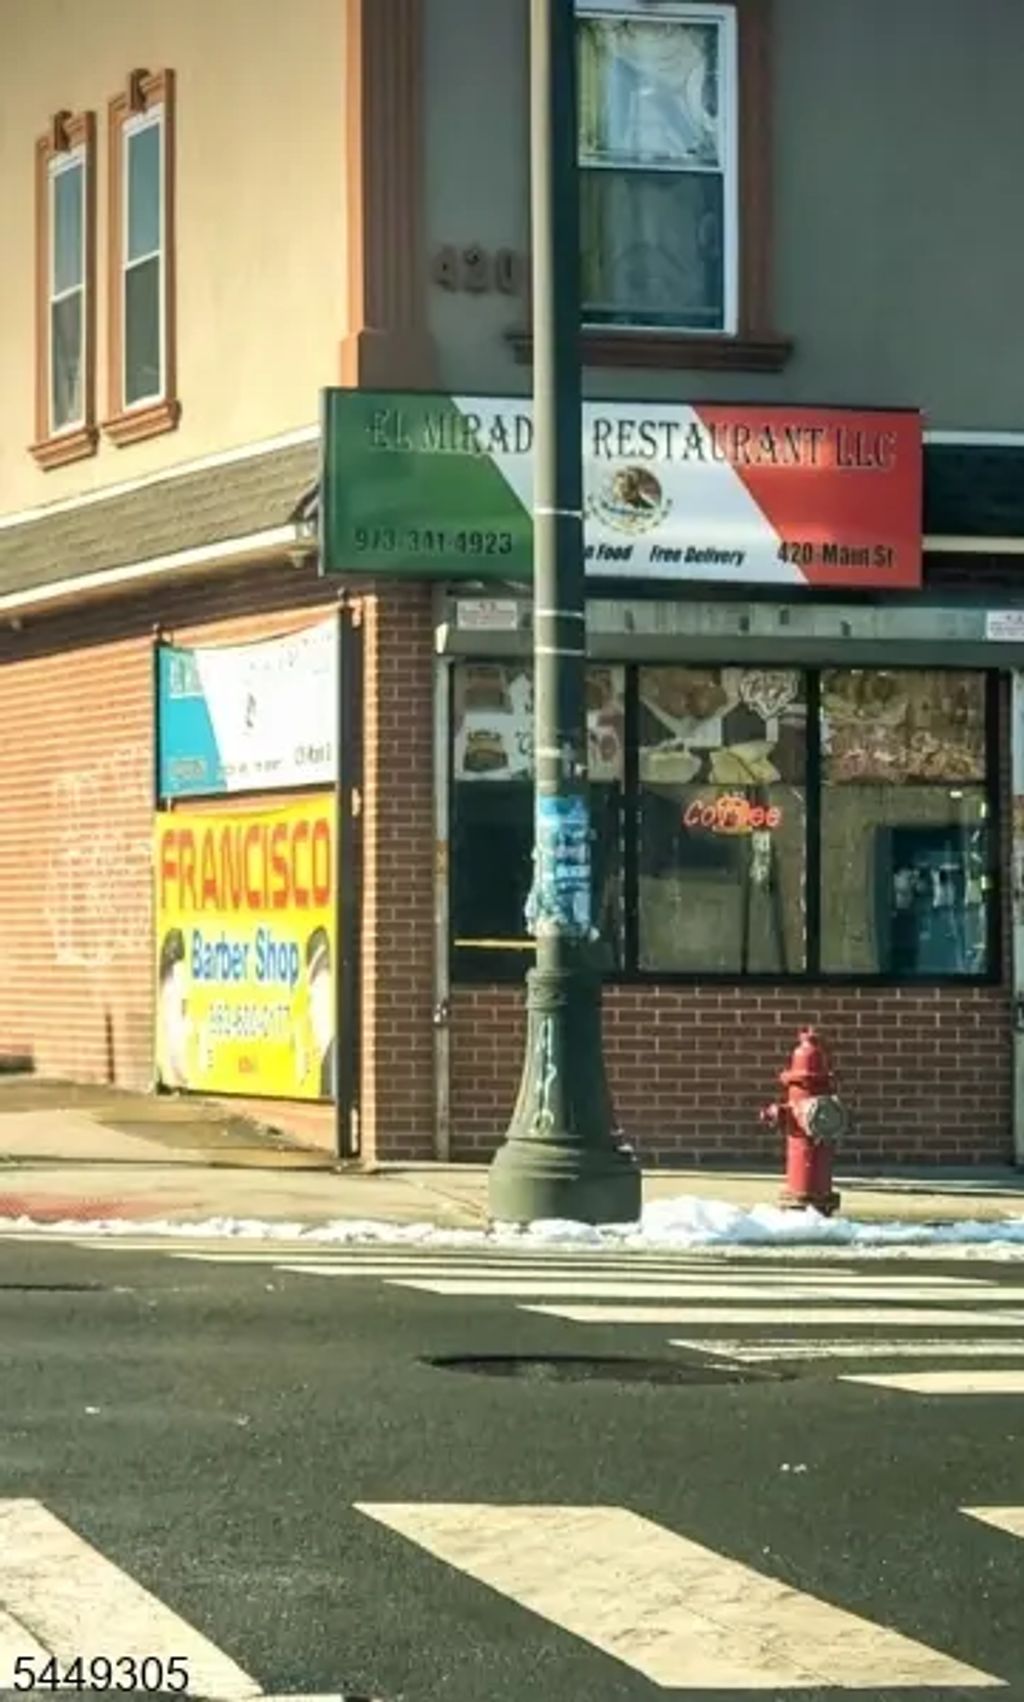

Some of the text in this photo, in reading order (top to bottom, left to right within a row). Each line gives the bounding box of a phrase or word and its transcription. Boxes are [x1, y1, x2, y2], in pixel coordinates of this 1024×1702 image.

[366, 409, 898, 468] EL MIRAD RESTAURANT LLC
[596, 543, 635, 561] Food
[650, 545, 745, 567] Free Delivery
[160, 818, 331, 912] FRANCISCO
[191, 926, 299, 992] Barber Shop
